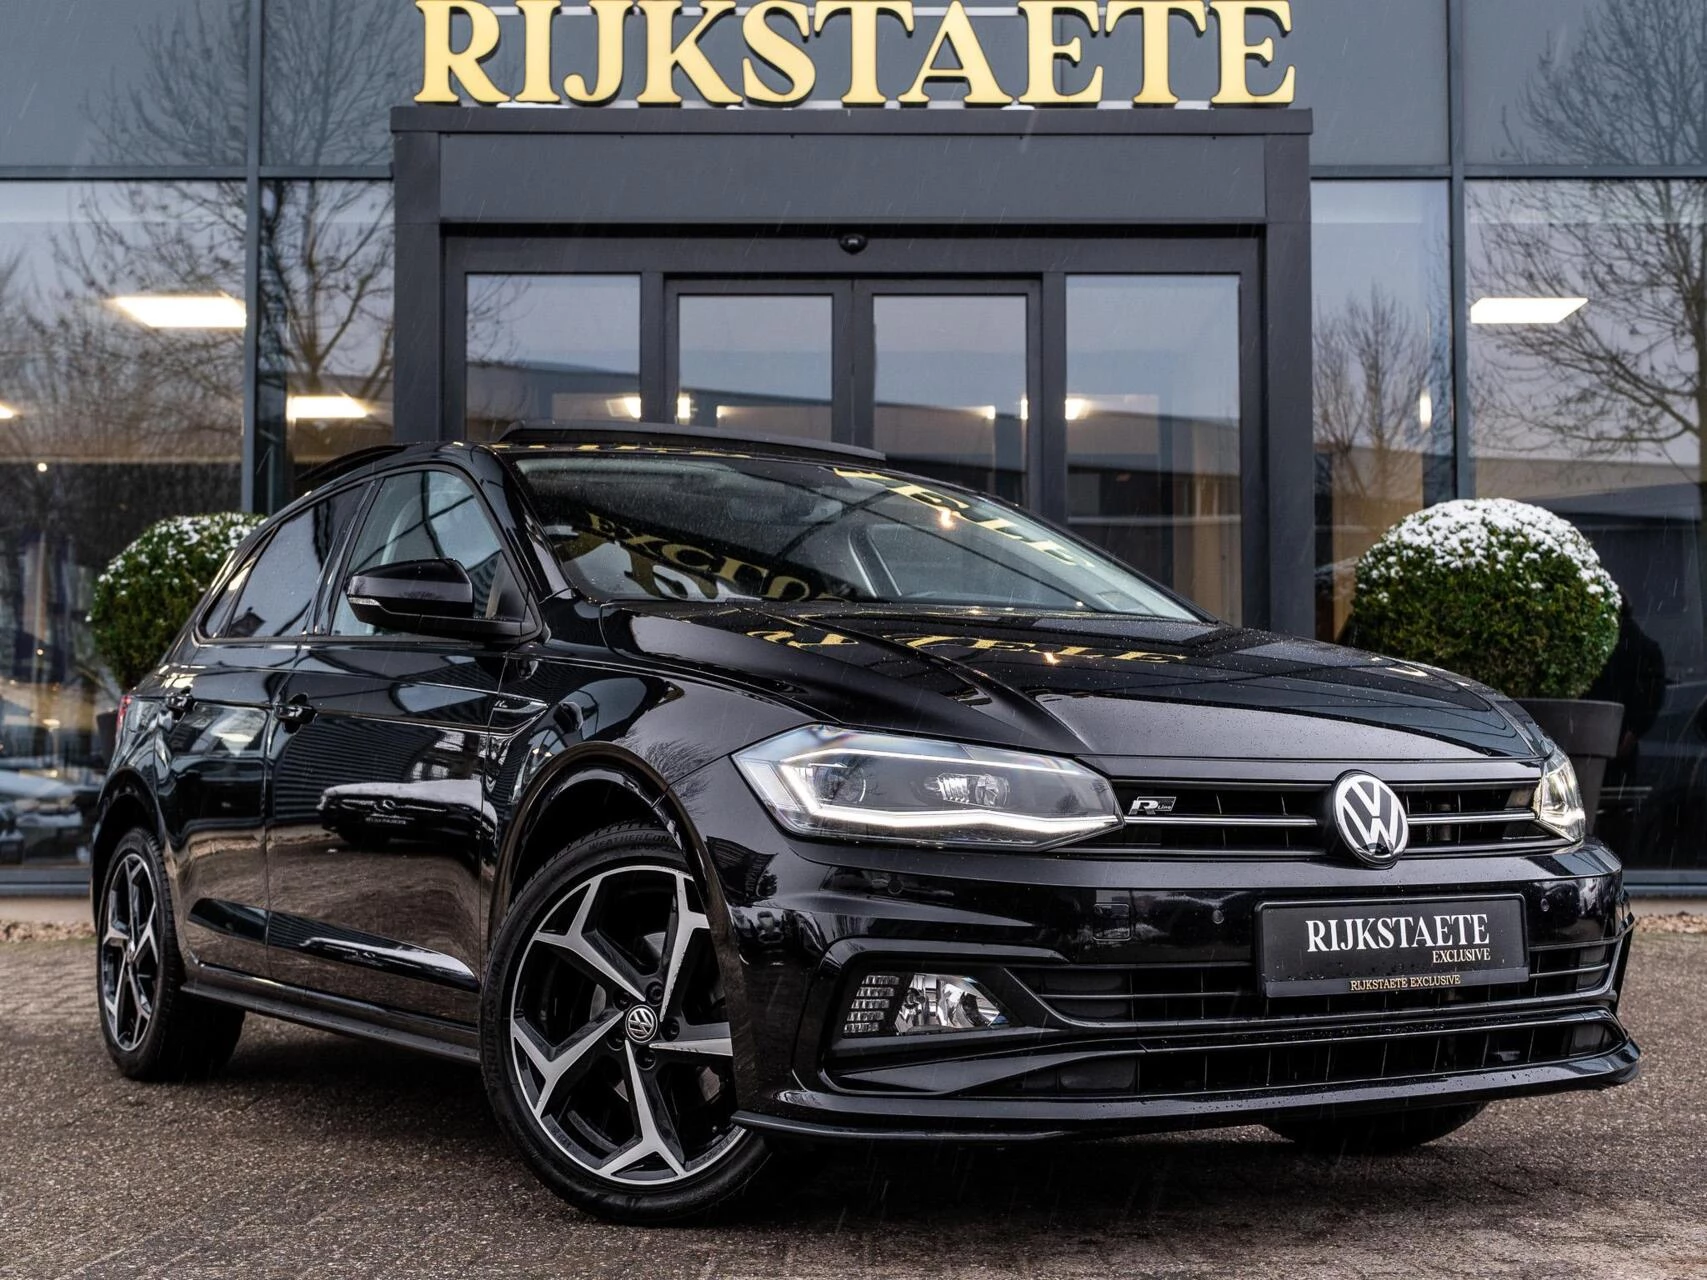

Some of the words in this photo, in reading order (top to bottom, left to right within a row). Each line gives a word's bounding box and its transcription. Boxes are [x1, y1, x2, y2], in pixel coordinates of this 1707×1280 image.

[413, 0, 1297, 106] RIJKSTAETE
[1305, 913, 1490, 953] RIJKSTAETE
[1432, 947, 1491, 964] EXCLUSIVE
[1350, 977, 1408, 992] RIJKSTAETE
[1410, 974, 1461, 988] EXCLUSIVE
